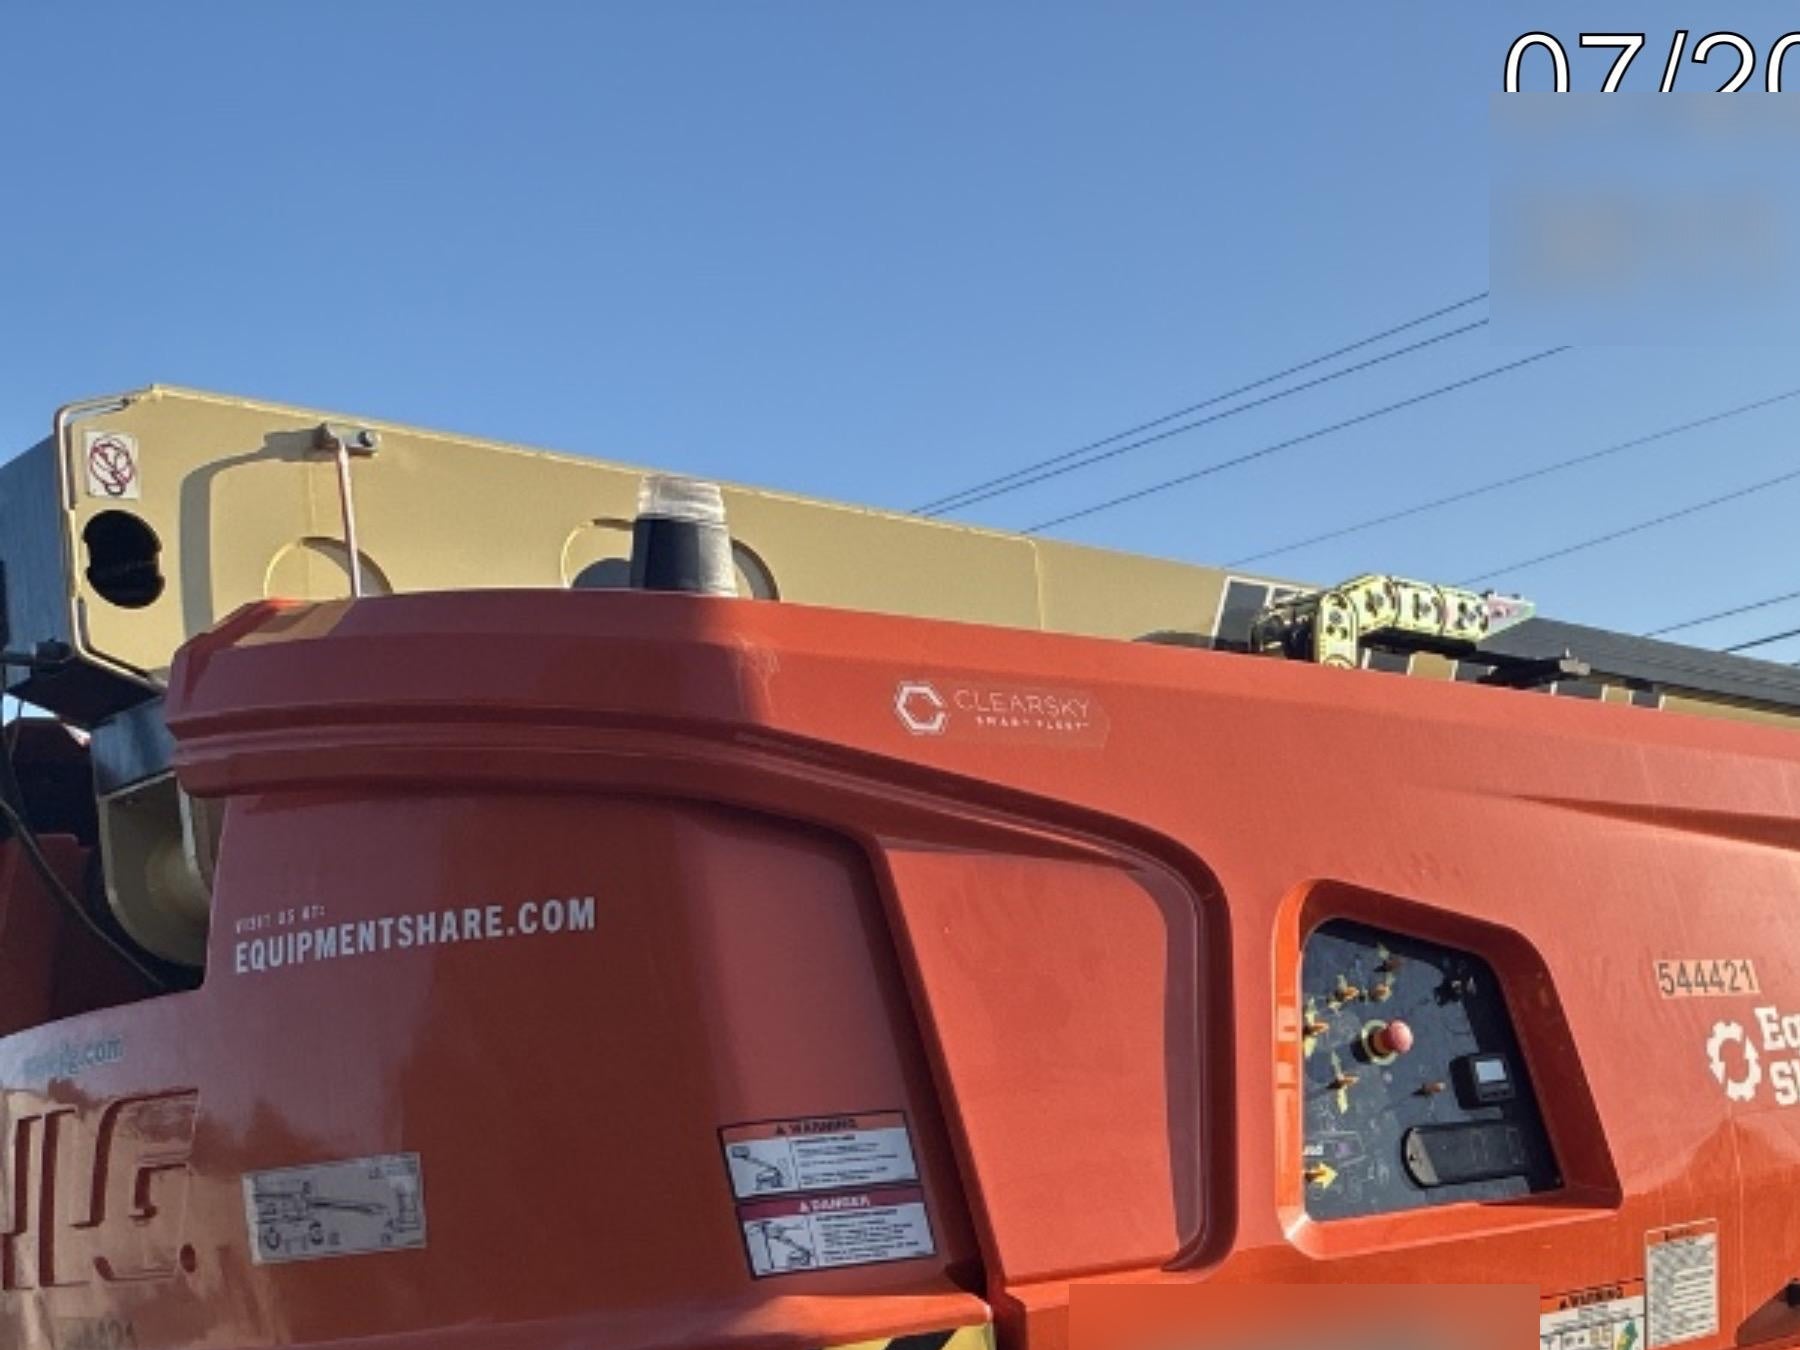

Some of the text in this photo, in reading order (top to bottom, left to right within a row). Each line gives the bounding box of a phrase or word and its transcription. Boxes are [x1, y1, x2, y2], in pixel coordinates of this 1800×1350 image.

[953, 688, 1090, 718] CLEARSKY
[235, 896, 596, 974] EQUIPMENTSHARE.COM
[1657, 961, 1756, 997] 544421
